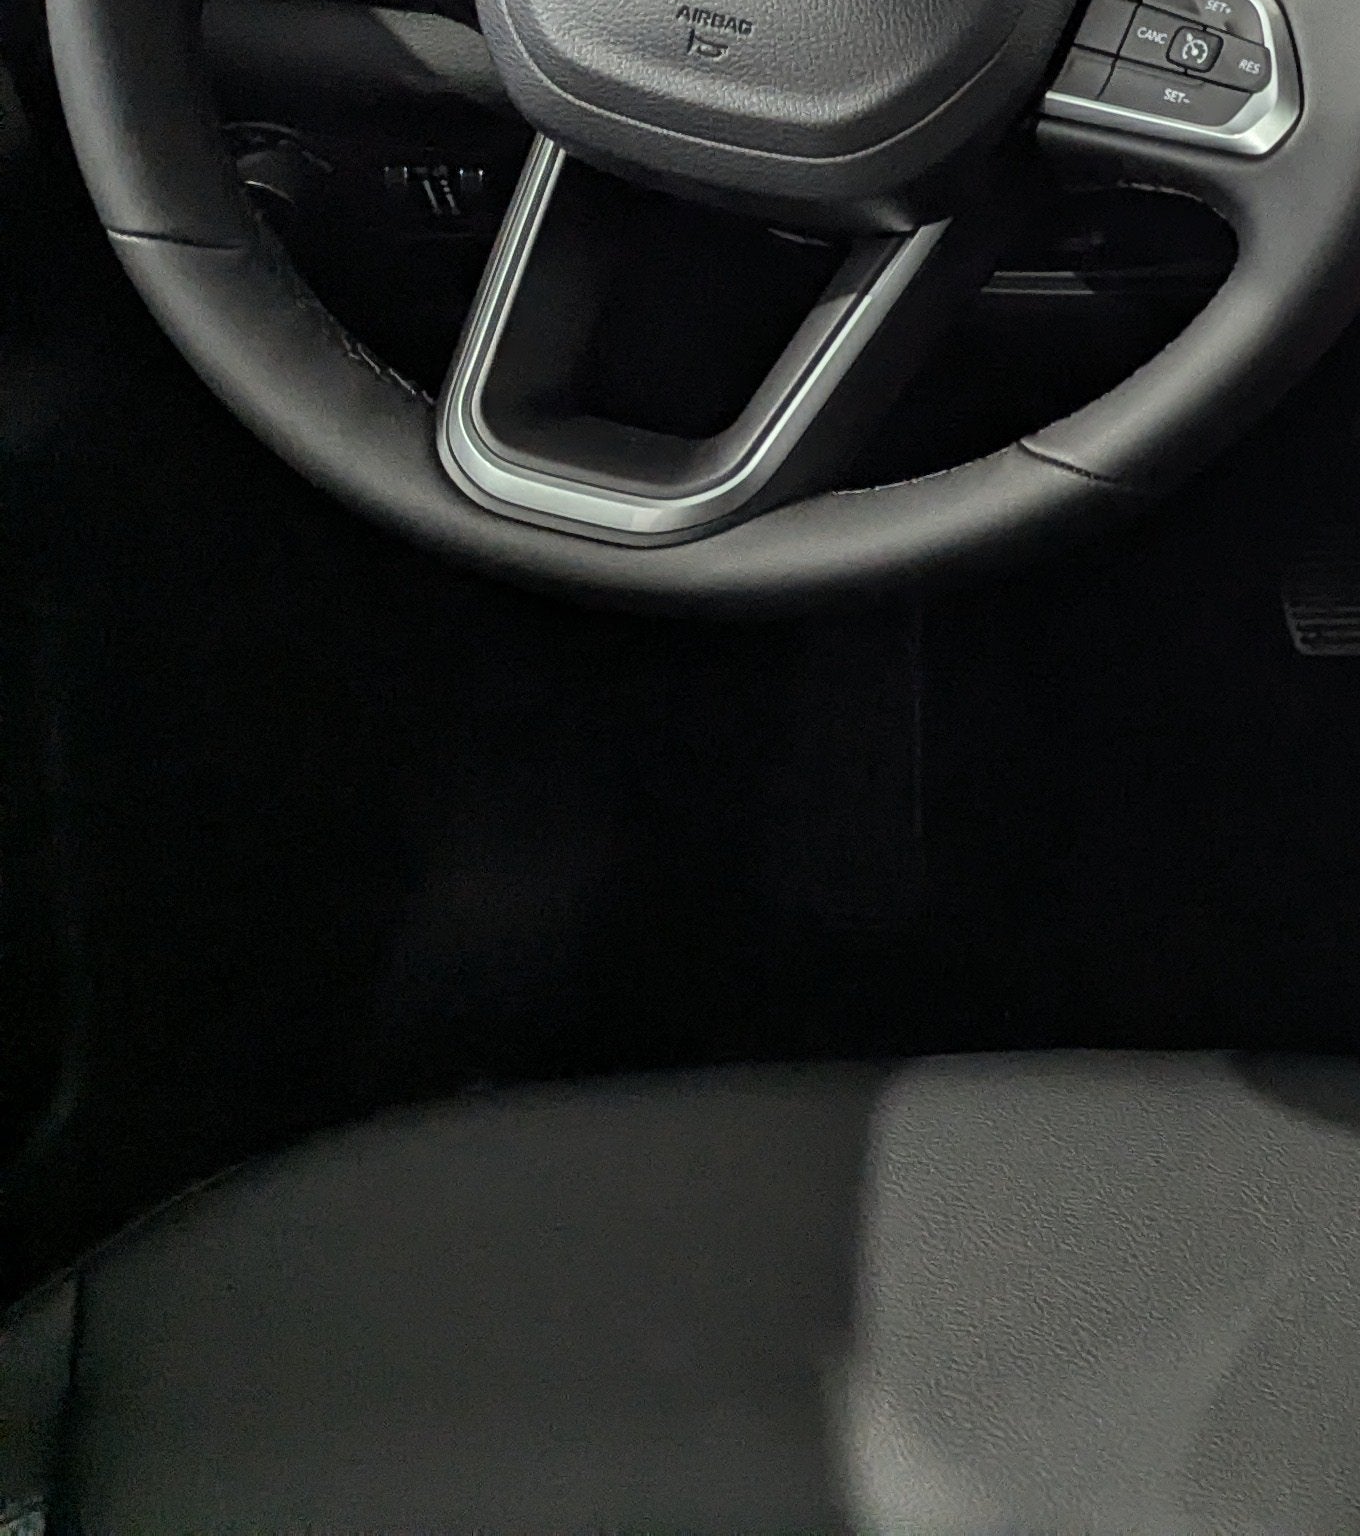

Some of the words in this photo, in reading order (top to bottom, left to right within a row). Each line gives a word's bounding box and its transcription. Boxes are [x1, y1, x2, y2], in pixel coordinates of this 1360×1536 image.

[675, 4, 754, 35] AIRBAG
[1136, 26, 1168, 45] CANC
[1238, 58, 1261, 74] RES
